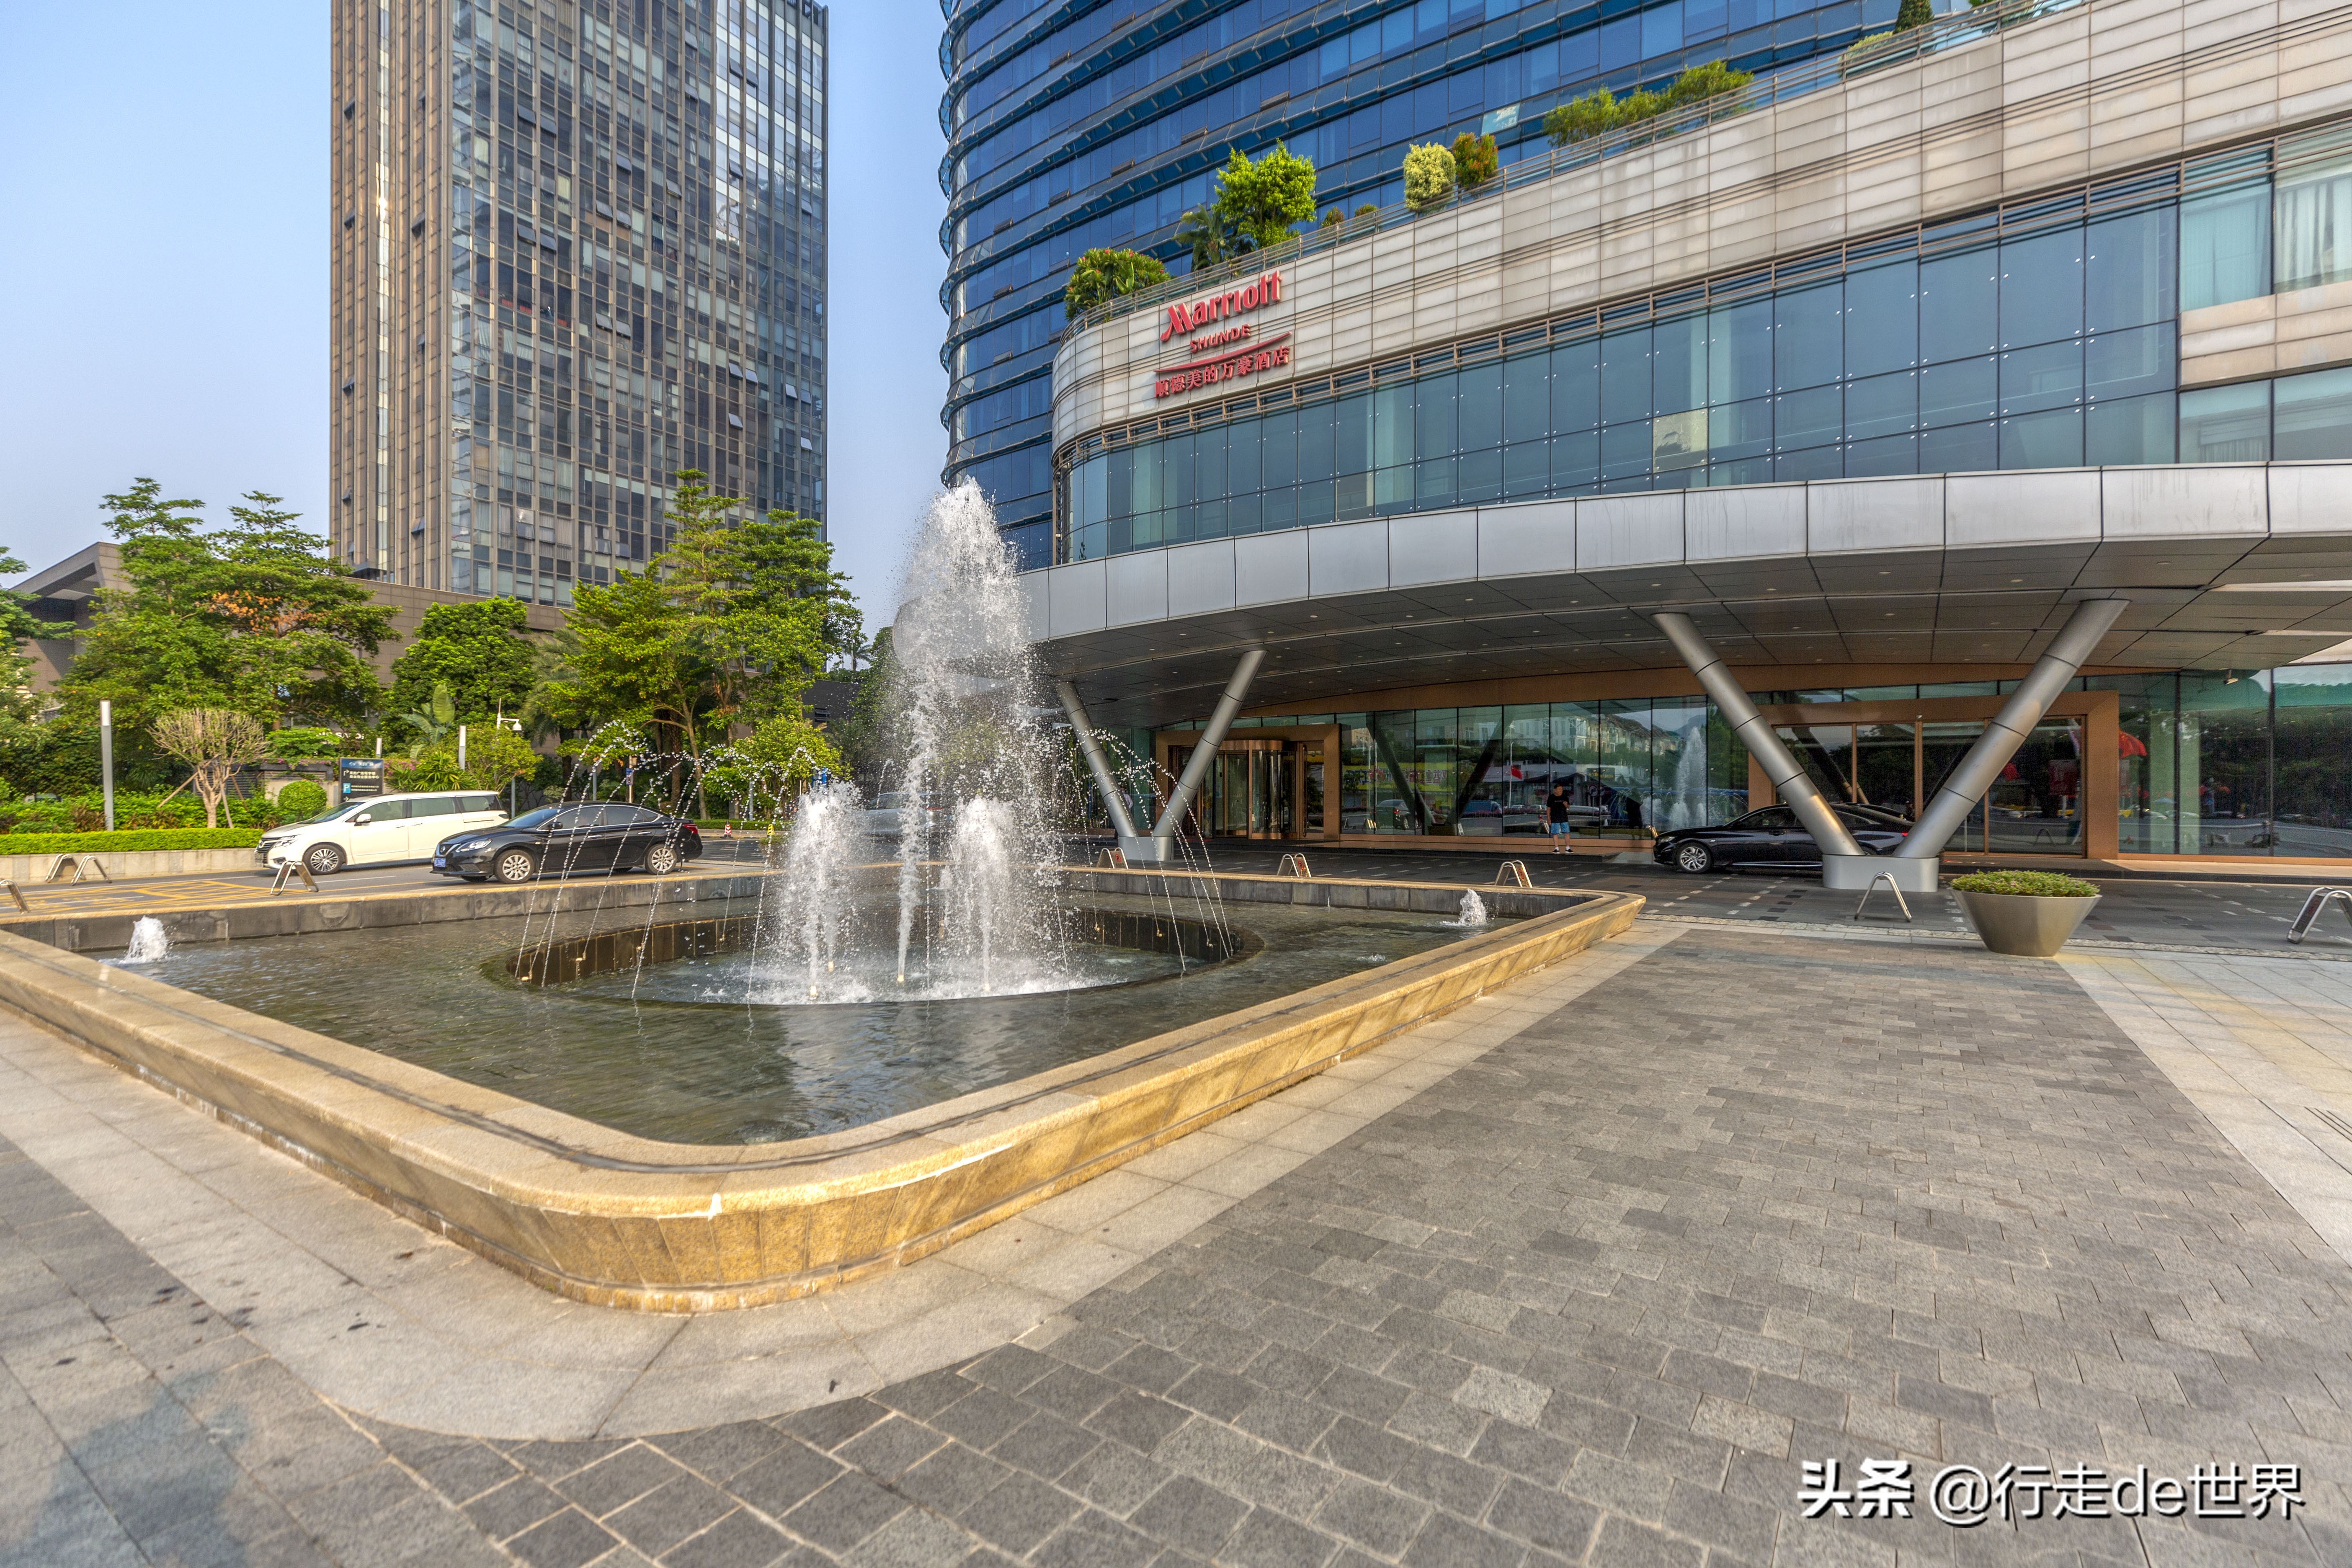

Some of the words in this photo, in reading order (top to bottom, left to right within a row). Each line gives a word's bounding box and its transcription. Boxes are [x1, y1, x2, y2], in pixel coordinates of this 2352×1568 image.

[1160, 270, 1283, 342] Marriott
[1190, 323, 1250, 354] SHUNDE
[1154, 345, 1290, 399] 顺德美的万豪酒店
